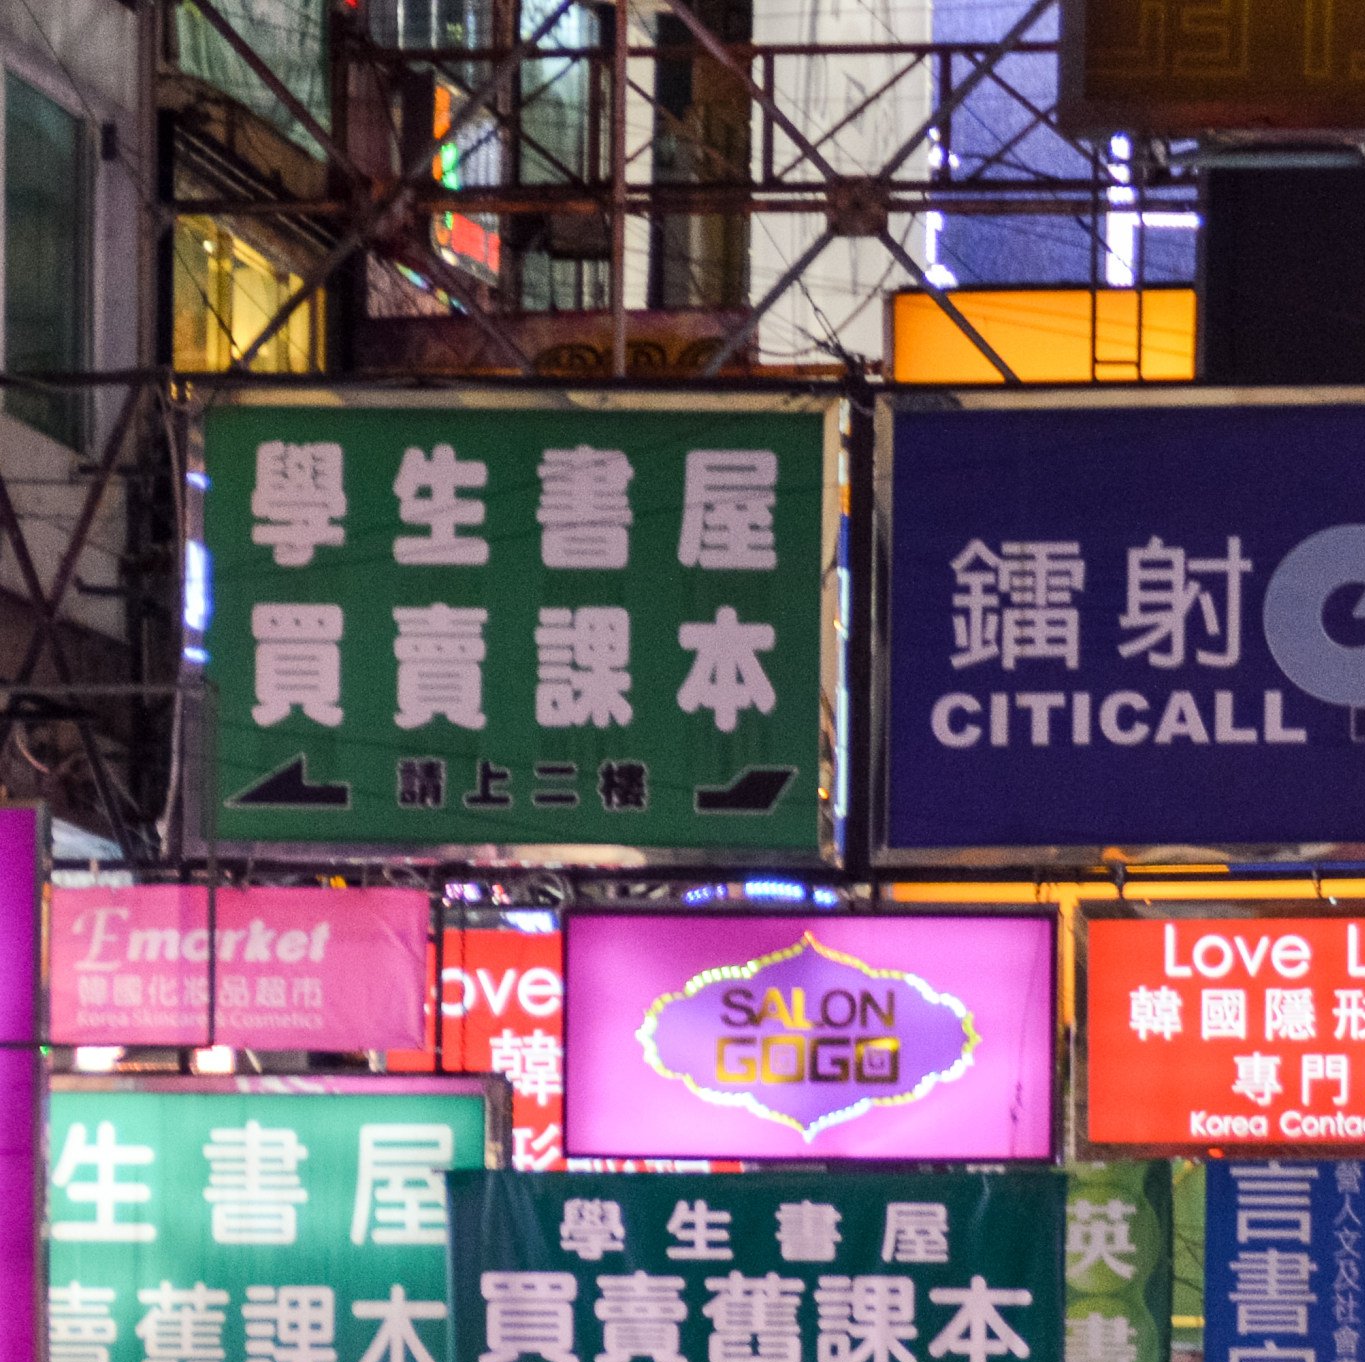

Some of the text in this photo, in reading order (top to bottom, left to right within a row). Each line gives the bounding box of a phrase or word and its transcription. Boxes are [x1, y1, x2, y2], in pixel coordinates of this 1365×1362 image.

[251, 440, 779, 570] 學生書屋
[251, 601, 778, 732] 買賣課本
[931, 691, 1307, 748] CITICALL
[397, 758, 649, 809] 請上二樓
[1163, 923, 1311, 980] Love
[424, 966, 563, 1018] ove
[718, 986, 897, 1030] SALON
[715, 1034, 901, 1086] GOGO
[1190, 1111, 1267, 1138] Korea
[559, 1199, 950, 1262] 學生書屋
